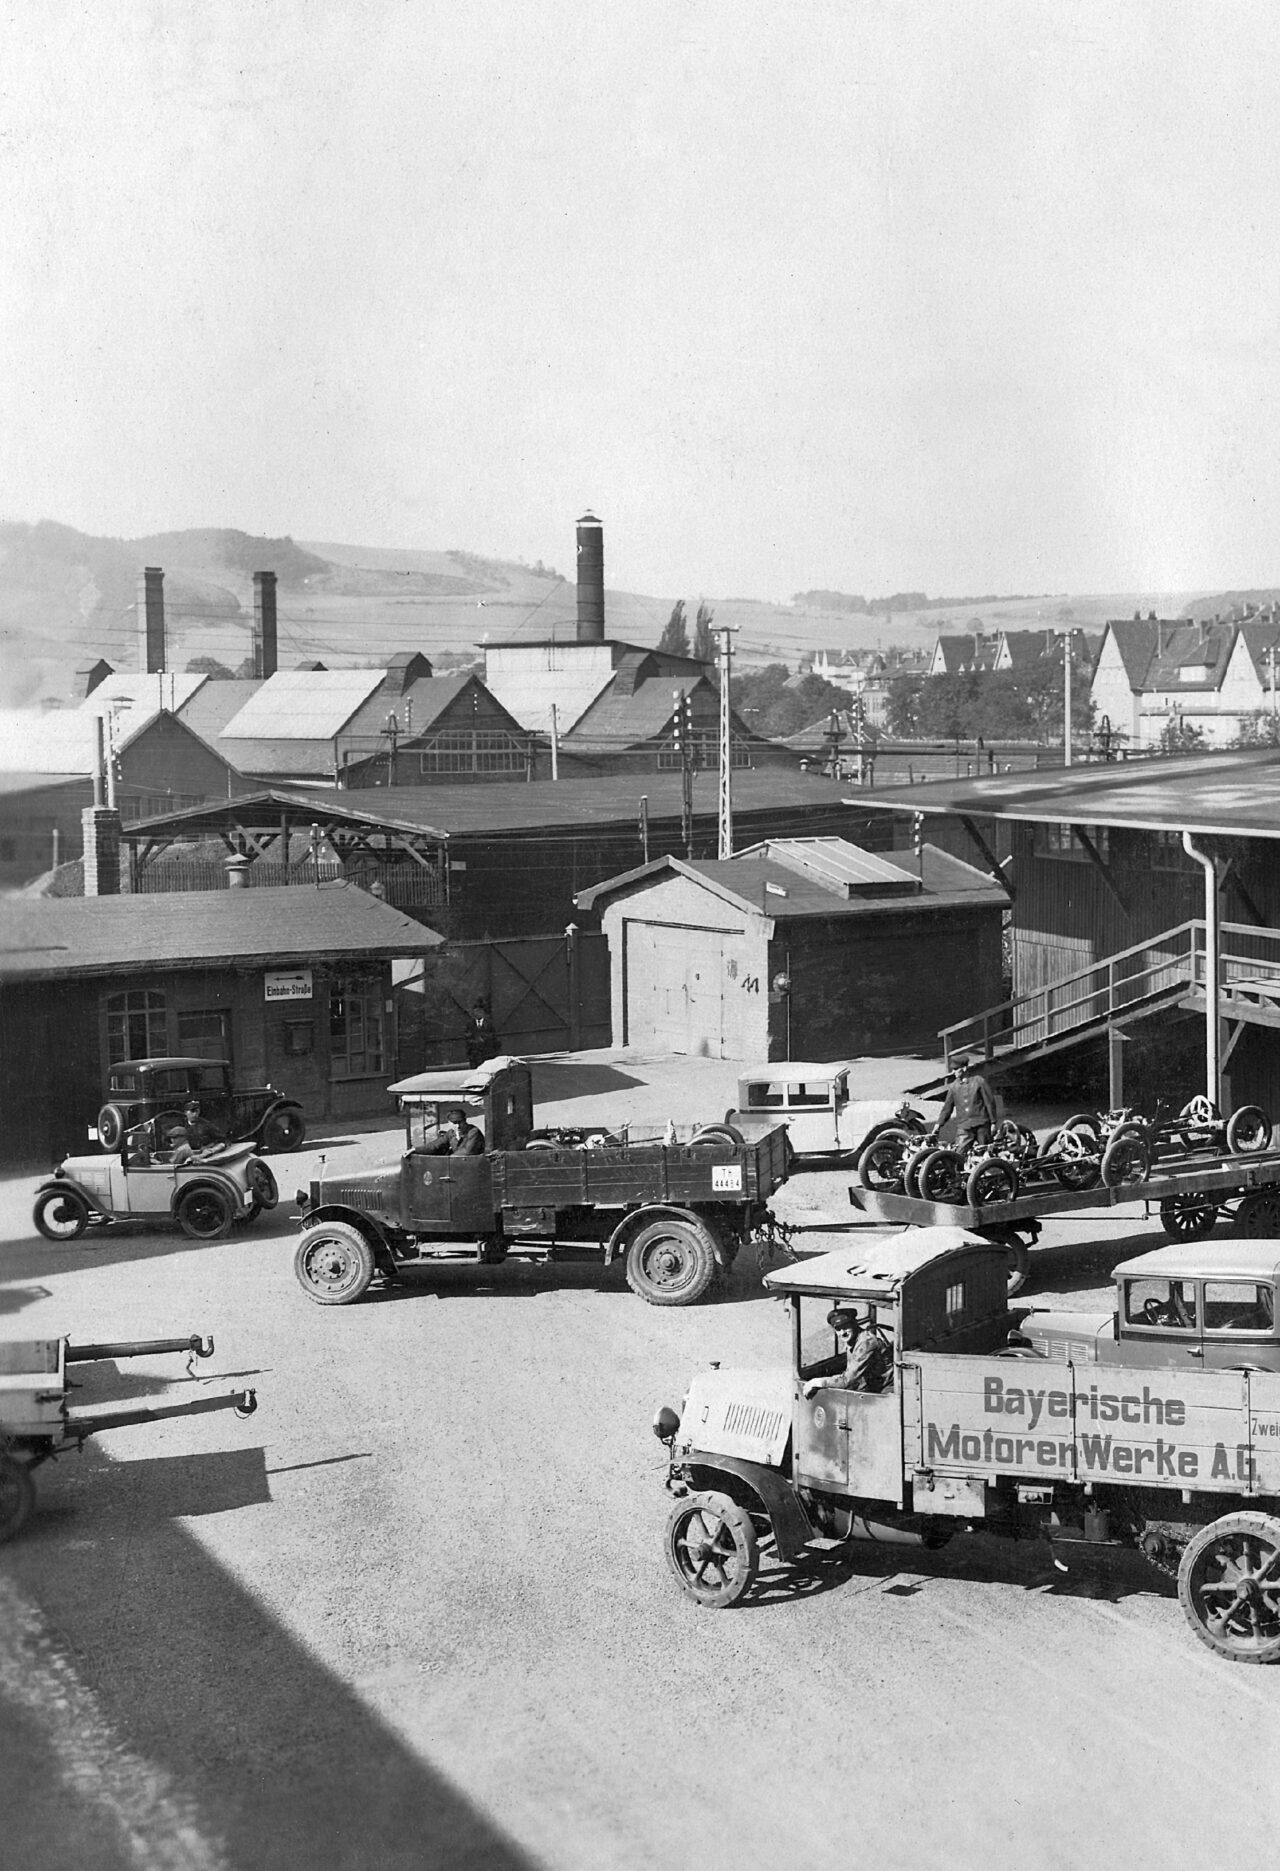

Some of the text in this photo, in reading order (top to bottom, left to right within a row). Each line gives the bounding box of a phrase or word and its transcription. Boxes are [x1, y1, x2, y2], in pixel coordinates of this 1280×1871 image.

[984, 1377, 1186, 1430] Bayerische
[928, 1422, 1079, 1469] Motoren
[1081, 1433, 1199, 1478] Werke
